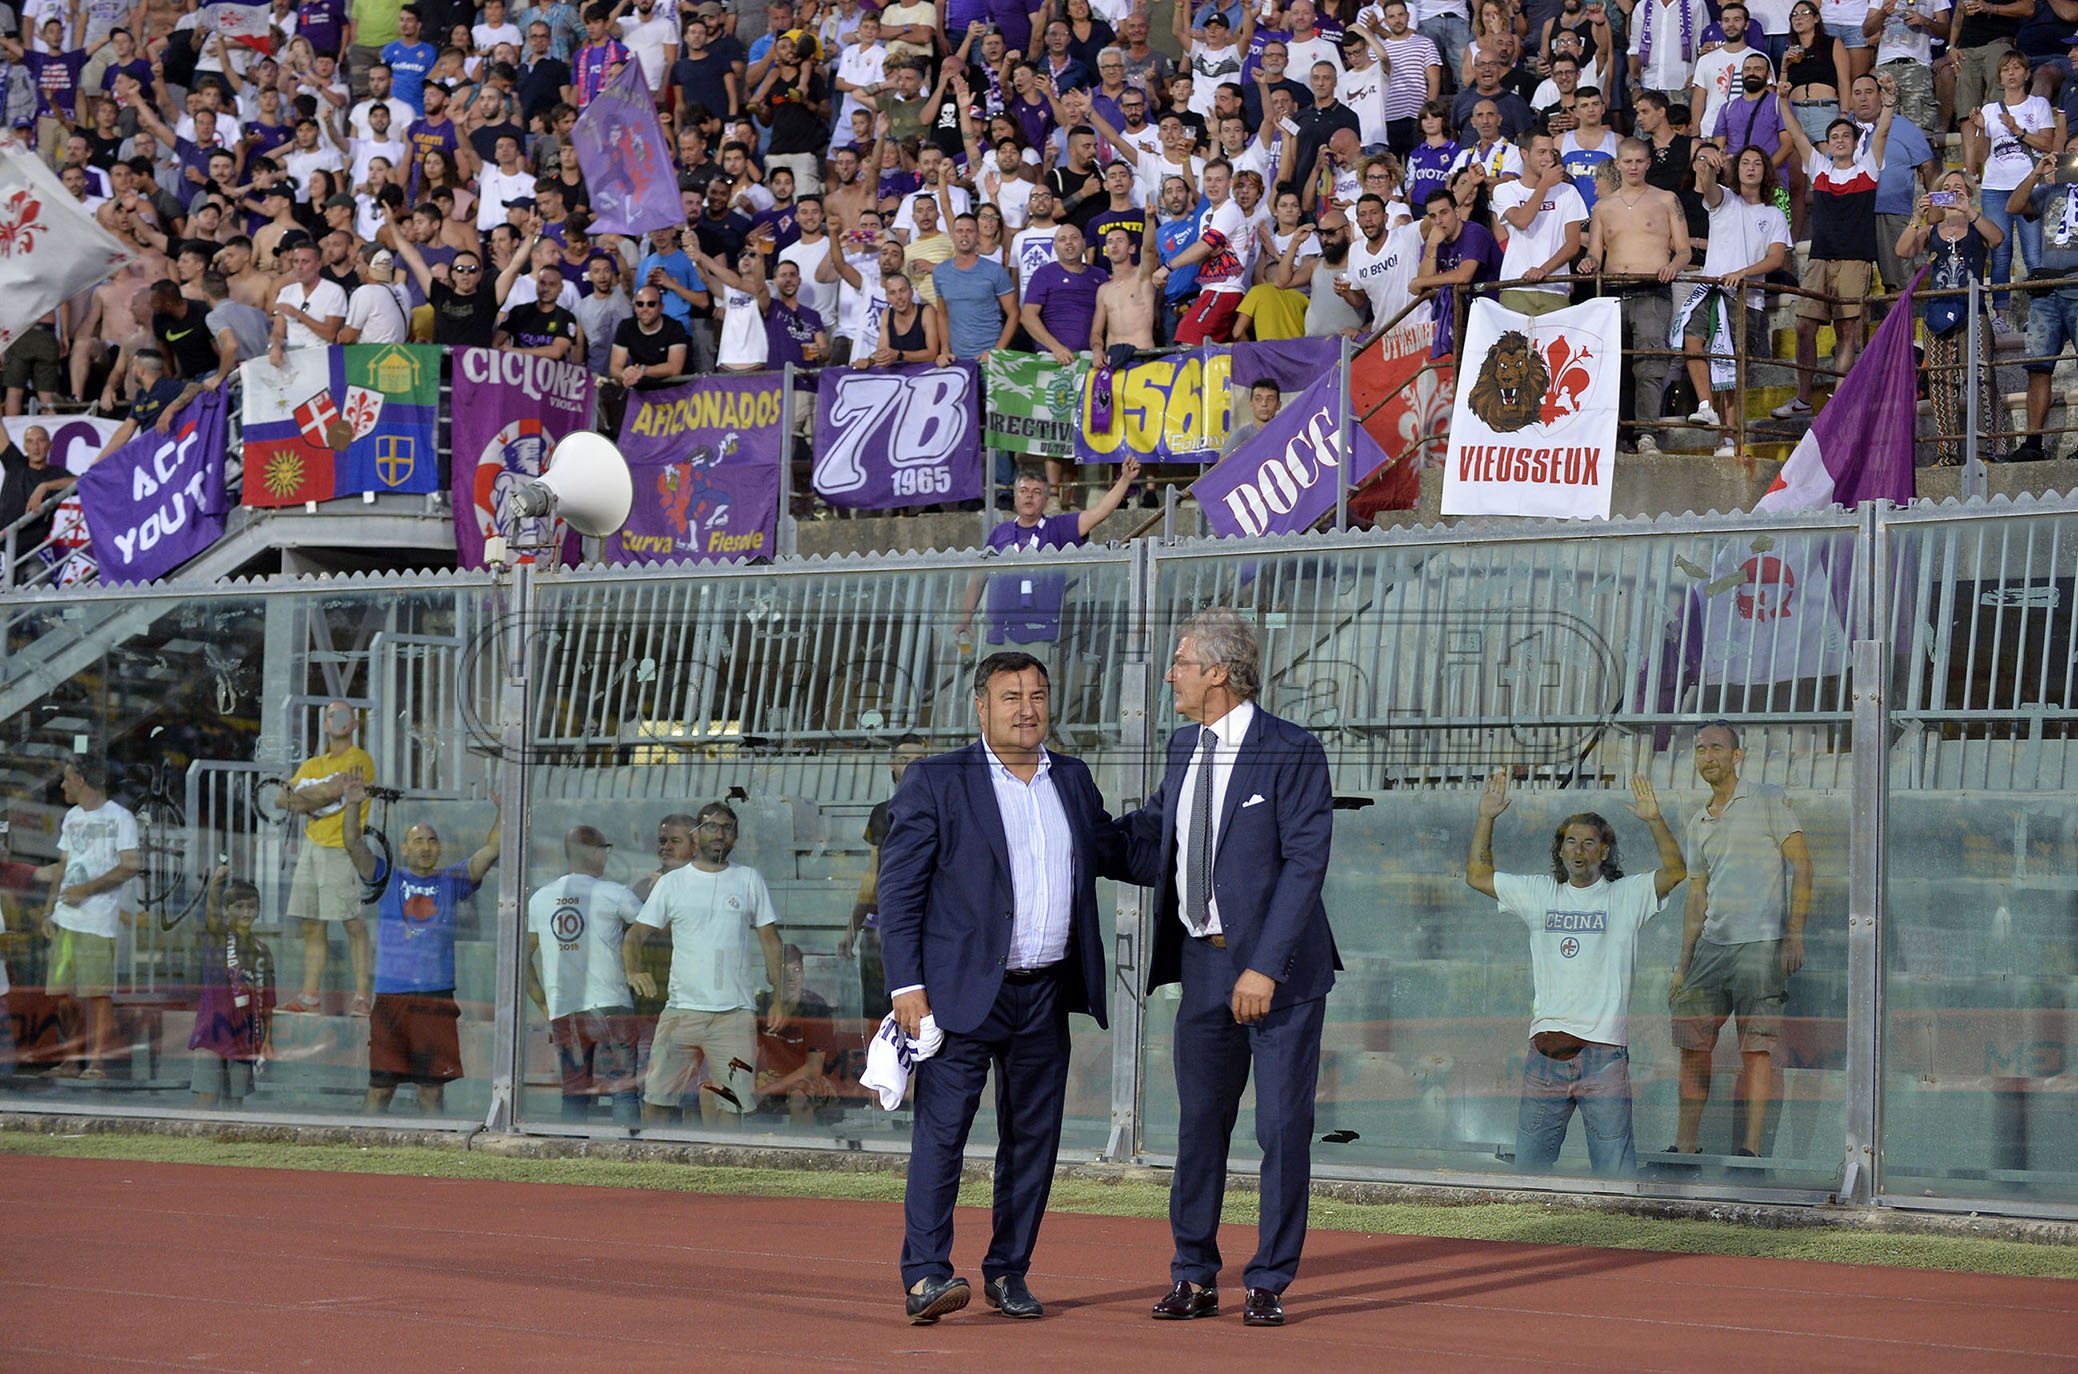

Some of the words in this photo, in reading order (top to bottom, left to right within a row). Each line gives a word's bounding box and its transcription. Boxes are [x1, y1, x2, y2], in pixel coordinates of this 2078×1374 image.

[1415, 168, 1449, 181] OYOTA
[1371, 254, 1399, 276] BEVO!
[462, 347, 587, 401] CICLONE
[631, 388, 783, 438] AFICIONADOS
[1222, 406, 1352, 537] DOCG
[1459, 445, 1601, 486] VIEUSSEUX
[891, 465, 951, 497] 1965
[114, 463, 213, 565] YOUT
[622, 530, 674, 554] Curva
[707, 528, 765, 553] Fiesole
[556, 897, 580, 905] 2008
[556, 914, 578, 936] 10
[1546, 913, 1605, 930] CECINA
